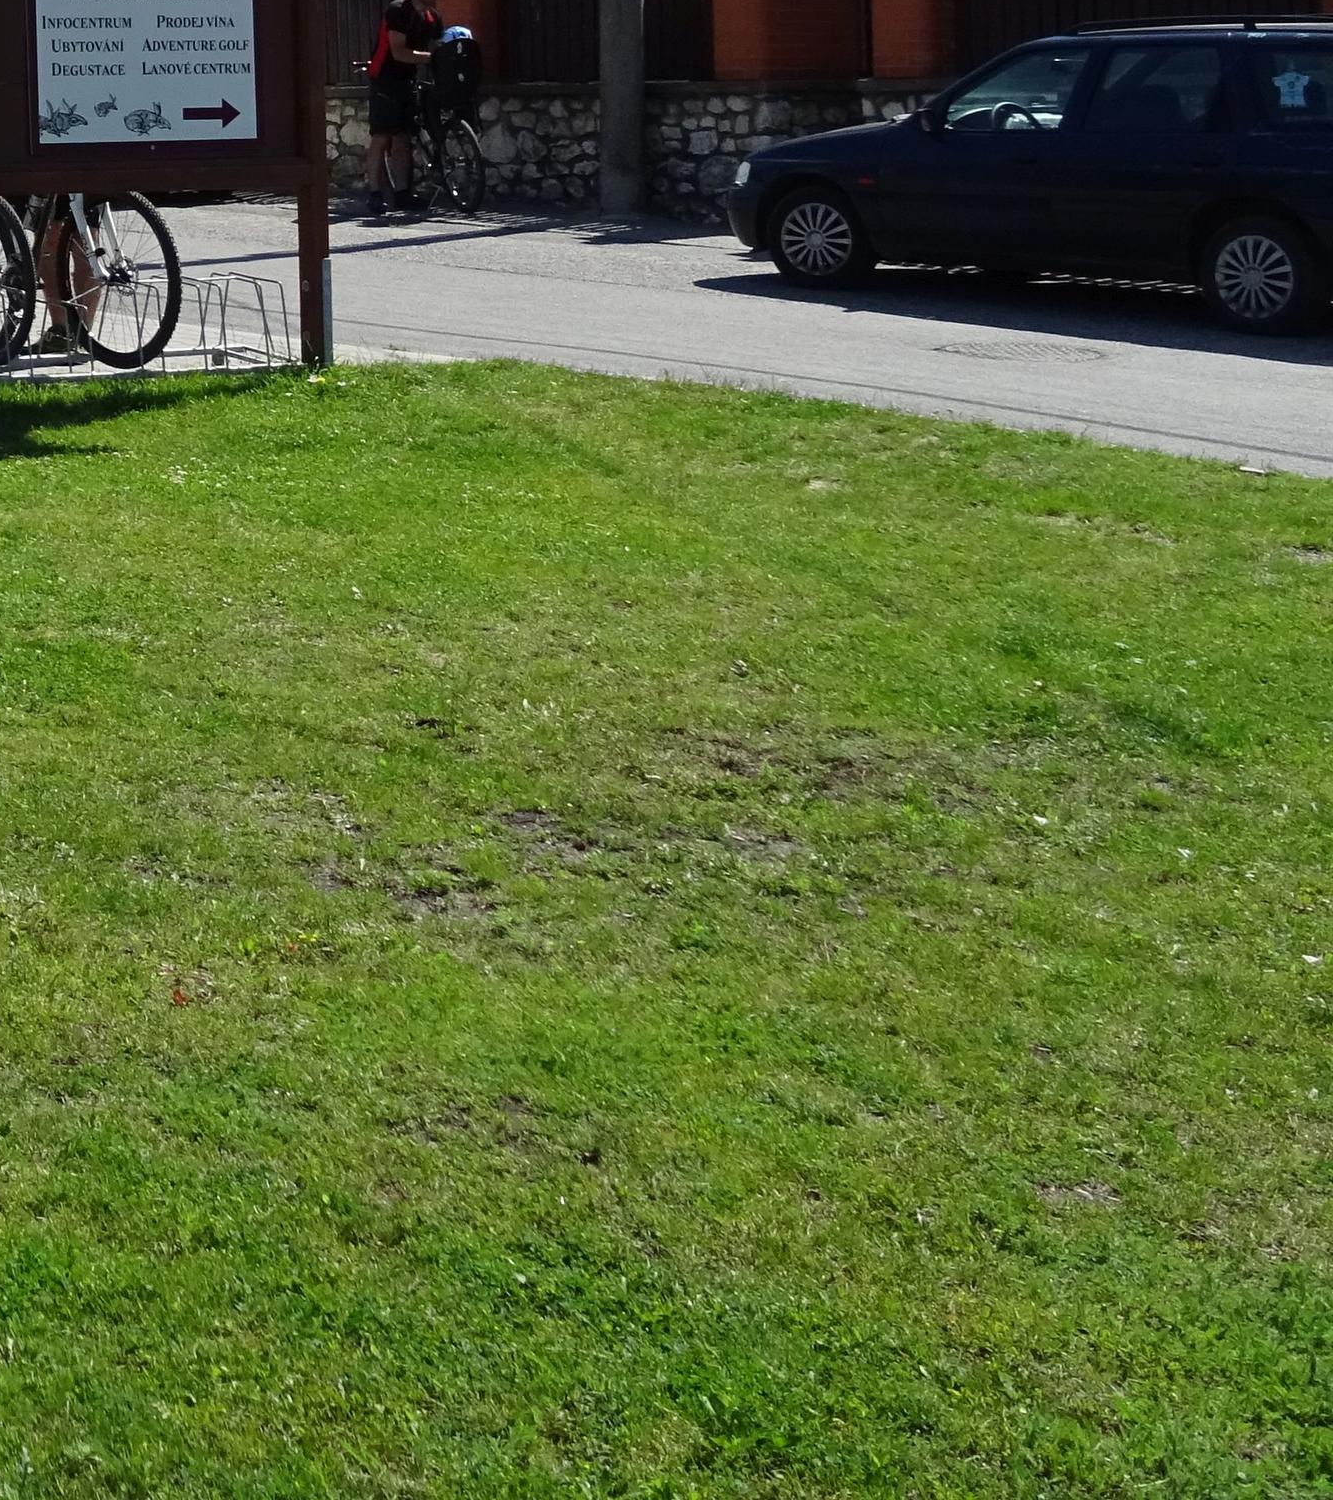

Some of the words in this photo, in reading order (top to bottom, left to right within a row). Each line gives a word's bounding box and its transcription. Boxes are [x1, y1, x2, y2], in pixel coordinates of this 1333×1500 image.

[41, 15, 133, 29] INFOCENTRUM
[156, 14, 204, 29] PRODEJ
[206, 15, 235, 28] VÍNA
[51, 38, 125, 53] UBYTOVÁNÍ
[142, 38, 217, 52] ADVENTURE
[218, 38, 251, 51] GOLF
[51, 62, 126, 76] DEGUSTACE
[142, 61, 192, 75] LANOVÉ
[194, 62, 252, 75] CENTRUM
